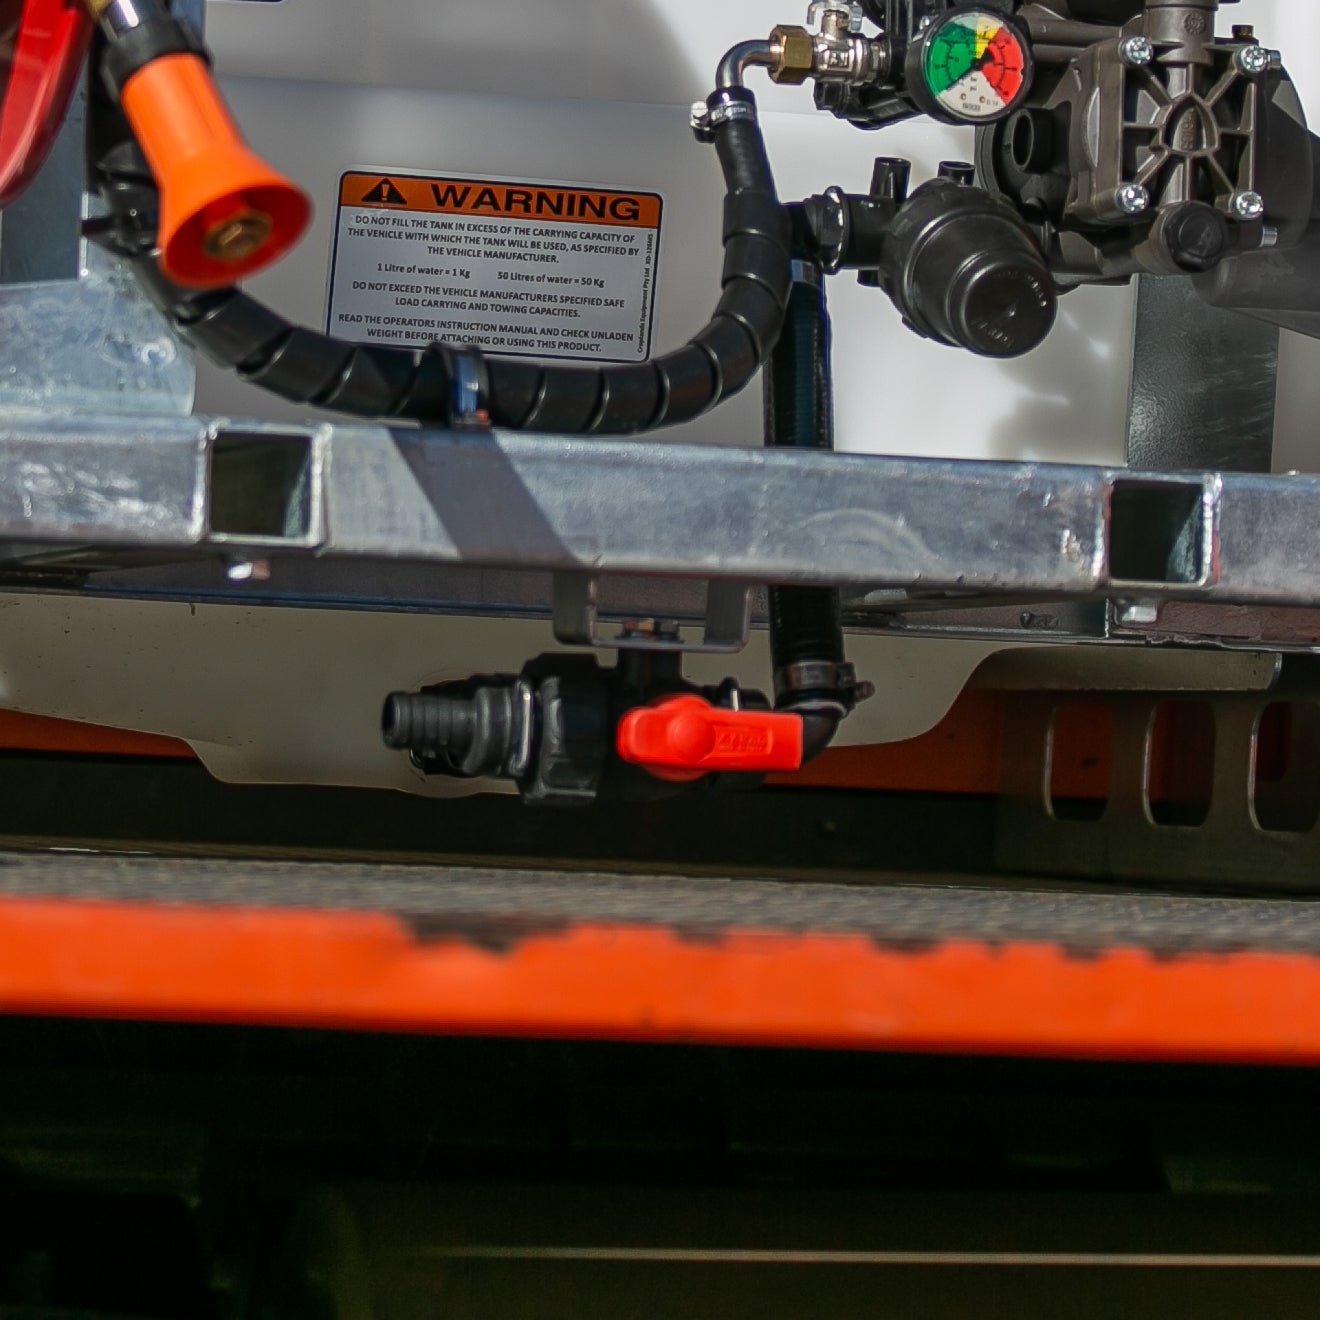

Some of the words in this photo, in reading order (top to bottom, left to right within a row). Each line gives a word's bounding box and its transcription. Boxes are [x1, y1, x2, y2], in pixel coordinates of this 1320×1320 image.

[430, 183, 640, 221] WARNING
[347, 227, 365, 237] THE
[366, 229, 403, 240] VEHICLE
[404, 231, 429, 242] WITH
[430, 233, 462, 244] WHICH
[464, 236, 481, 245] THE
[482, 237, 506, 247] TANK
[507, 239, 529, 249] WILL
[530, 240, 541, 250] BE
[542, 241, 569, 252] USED,
[570, 243, 582, 253] AS
[583, 244, 626, 256] SPECIFIED
[627, 248, 640, 257] BY
[355, 215, 370, 225] DO
[370, 216, 391, 226] NOT
[391, 218, 410, 228] FILL
[410, 219, 428, 229] THE
[429, 220, 454, 231] TANK
[454, 222, 465, 232] IN
[466, 223, 499, 234] EXCESS
[499, 225, 512, 235] OF
[513, 226, 531, 236] THE
[531, 227, 578, 239] CARRYING
[579, 230, 622, 242] CAPACITY
[622, 233, 635, 243] OF
[427, 246, 444, 256] THE
[445, 248, 482, 258] VEHICLE
[483, 250, 560, 264] MANUFACTURER.
[377, 263, 383, 271] 1
[384, 264, 405, 273] Litre
[406, 265, 417, 274] of
[417, 267, 444, 276] water
[452, 268, 457, 276] 1
[459, 269, 471, 279] Kg
[497, 271, 509, 280] 50
[510, 272, 534, 282] Litres
[535, 273, 545, 283] of
[546, 276, 572, 285] water
[581, 277, 592, 286] 50
[593, 278, 605, 288] Kg
[642, 278, 650, 289] Pty
[352, 280, 367, 289] DO
[368, 281, 388, 291] NOT
[389, 283, 423, 294] EXCEED
[423, 286, 441, 295] THE
[442, 287, 478, 298] VEHICLE
[480, 290, 558, 304] MANUFACTURERS
[559, 296, 603, 307] SPECIFIED
[603, 299, 625, 309] SAFE
[395, 297, 420, 306] LOAD
[421, 299, 467, 310] CARRYING
[467, 302, 489, 311] AND
[490, 303, 528, 314] TOWING
[529, 306, 581, 318] CAPACITIES.
[640, 289, 648, 322] Equipment
[338, 313, 363, 323] READ
[364, 315, 382, 324] THE
[382, 316, 436, 328] OPERATORS
[436, 320, 497, 332] INSTRUCTION
[498, 324, 538, 335] MANUAL
[540, 327, 560, 337] AND
[560, 329, 590, 339] CHECK
[590, 331, 634, 342] UNLADEN
[366, 328, 403, 339] WEIGHT
[404, 331, 439, 341] BEFORE
[439, 333, 491, 345] ATTACHING
[491, 337, 505, 346] OR
[506, 338, 535, 348] USING
[536, 340, 556, 349] THIS
[557, 341, 602, 353] PRODUCT.
[637, 323, 645, 353] Croplands
